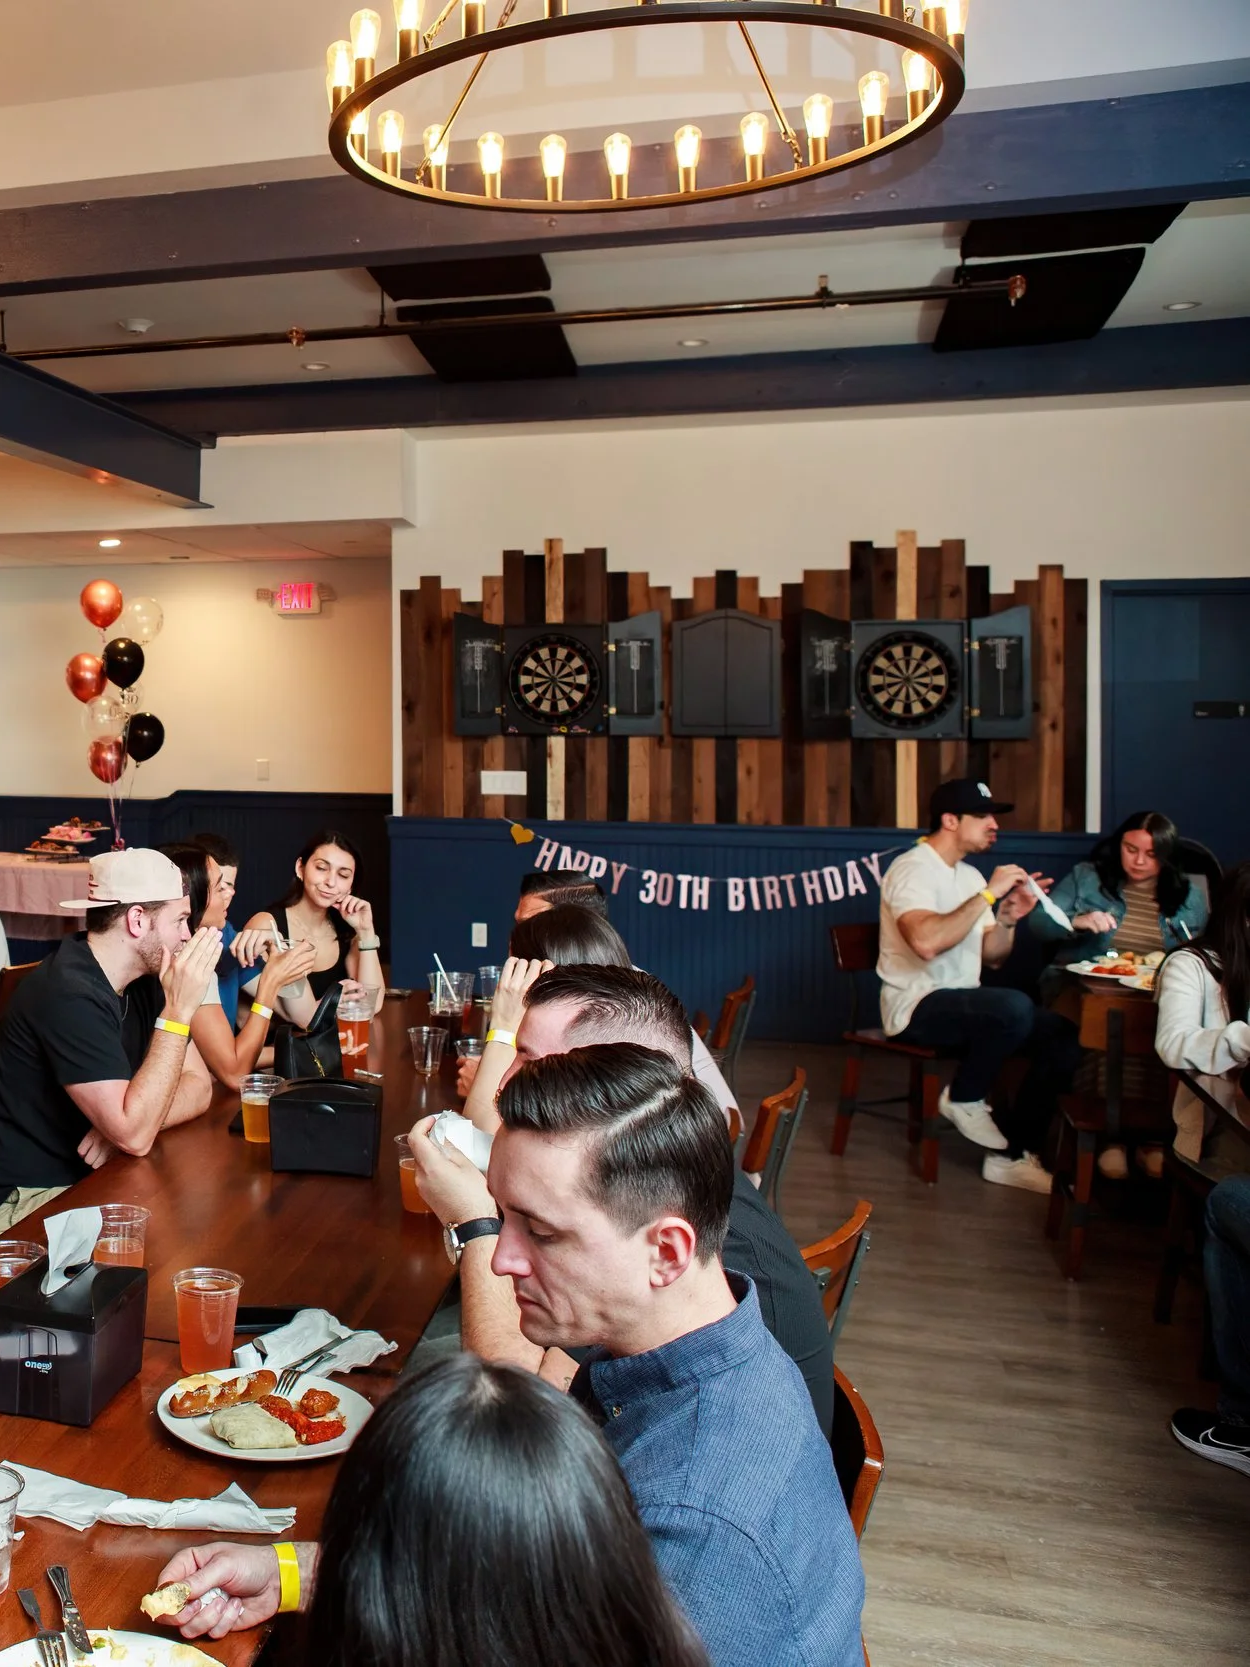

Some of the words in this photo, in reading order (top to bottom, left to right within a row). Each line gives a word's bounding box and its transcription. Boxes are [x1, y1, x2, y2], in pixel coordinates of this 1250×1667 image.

[281, 583, 314, 609] EXIT
[534, 838, 628, 895] HAPPY
[639, 869, 710, 911] 30TH
[727, 852, 882, 912] BIRTHDAY
